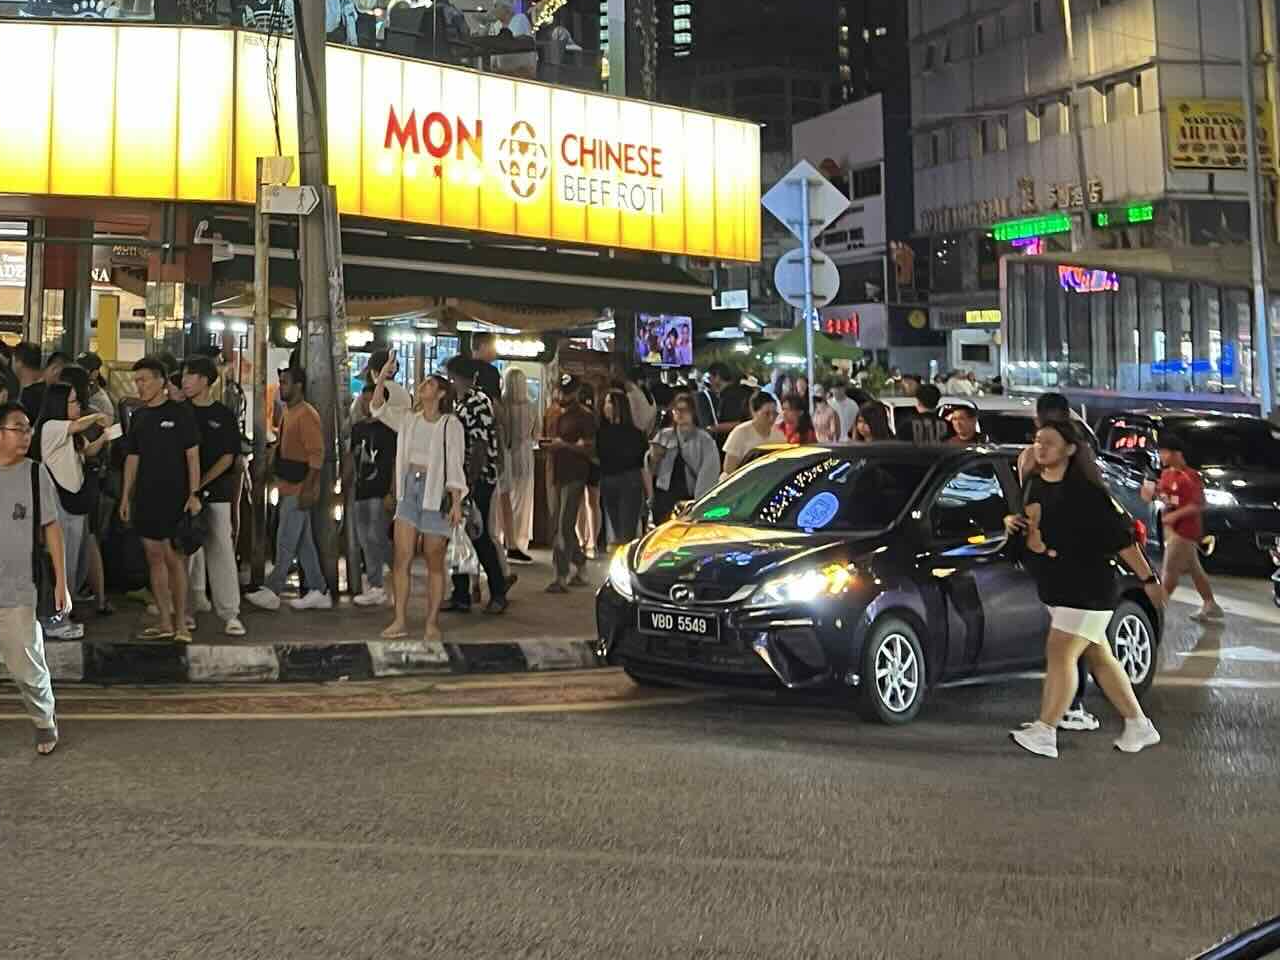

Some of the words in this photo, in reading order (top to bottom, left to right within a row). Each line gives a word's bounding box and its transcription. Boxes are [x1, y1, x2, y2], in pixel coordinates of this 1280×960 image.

[383, 103, 483, 162] MON
[561, 133, 663, 178] CHINESE
[564, 175, 611, 206] BEEF
[617, 181, 664, 214] ROTI
[651, 612, 673, 629] VBD
[678, 616, 707, 634] 5549
